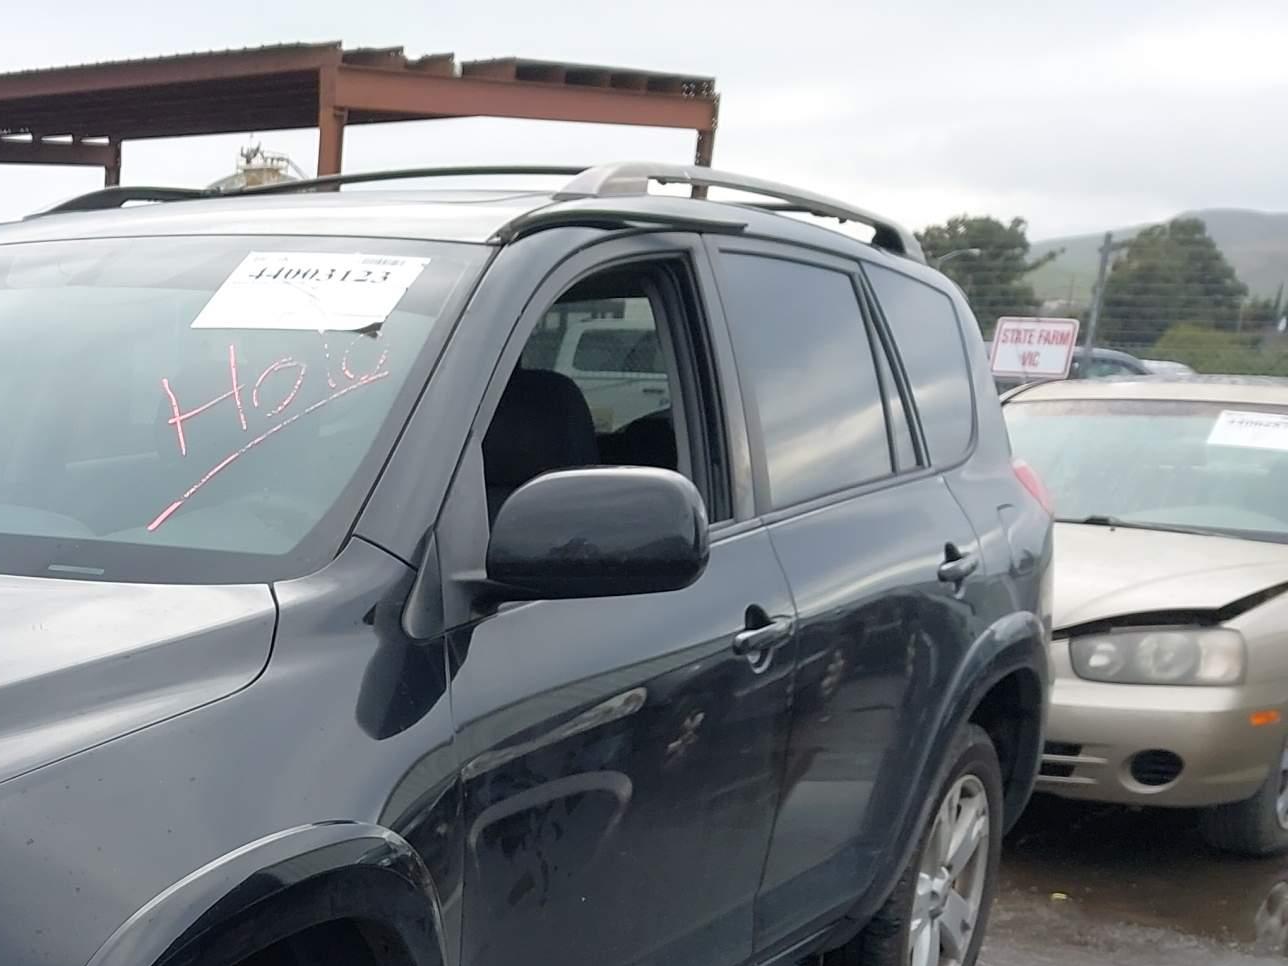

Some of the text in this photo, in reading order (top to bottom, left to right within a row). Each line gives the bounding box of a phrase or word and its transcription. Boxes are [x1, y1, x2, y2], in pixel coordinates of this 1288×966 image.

[248, 266, 391, 283] 44003123
[1002, 328, 1072, 346] STATE FARM
